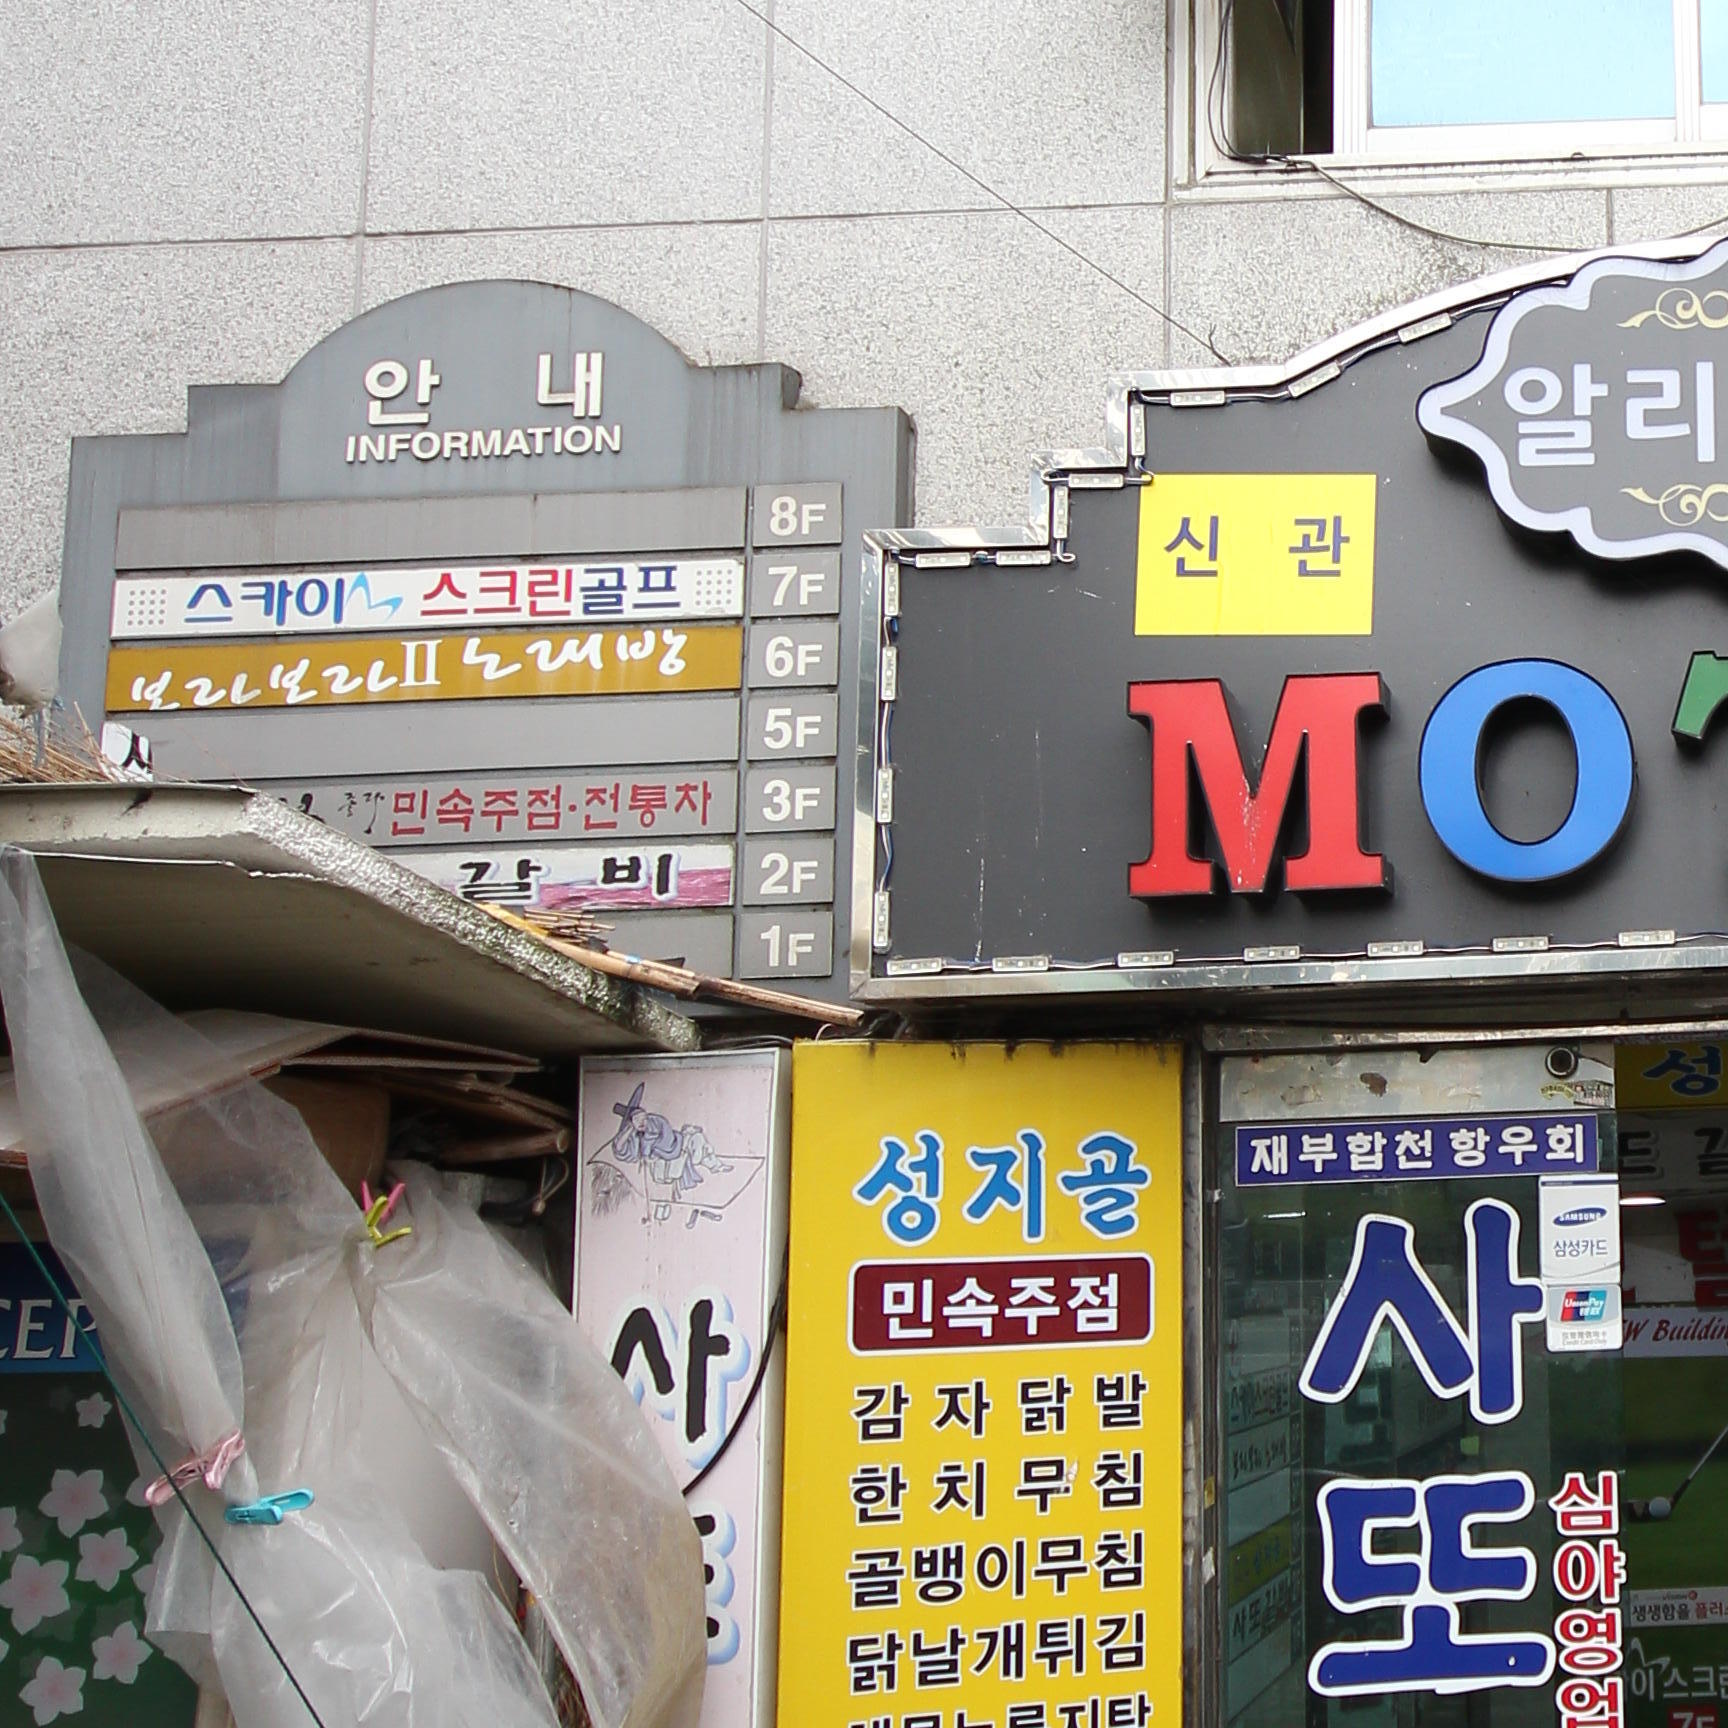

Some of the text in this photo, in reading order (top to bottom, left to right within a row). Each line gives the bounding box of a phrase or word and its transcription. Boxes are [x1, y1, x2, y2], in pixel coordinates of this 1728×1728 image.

[363, 350, 605, 427] 안내
[346, 424, 623, 464] INFORMATION
[769, 496, 826, 537] 8F
[1164, 512, 1353, 582] 신관
[183, 564, 683, 627] 스카이 스크린골프
[769, 565, 826, 608] 7F
[462, 628, 688, 682] 노래방
[765, 636, 822, 678] 6F
[763, 708, 822, 750] 5F
[763, 778, 821, 820] 3F
[458, 852, 680, 904] 갈비
[761, 854, 818, 896] 2F
[761, 927, 815, 968] 1F
[1249, 1127, 1433, 1175] 재부합천
[852, 1128, 1152, 1246] 성지골
[1560, 1210, 1602, 1224] SAMSUNG
[1553, 1238, 1608, 1259] 삼성카드
[882, 1273, 1120, 1339] 민속주점
[850, 1371, 1148, 1443] 감자닭발
[849, 1450, 1146, 1524] 한치무침
[847, 1531, 1145, 1610] 골뱅이무침
[846, 1613, 1146, 1695] 닭날개튀김
